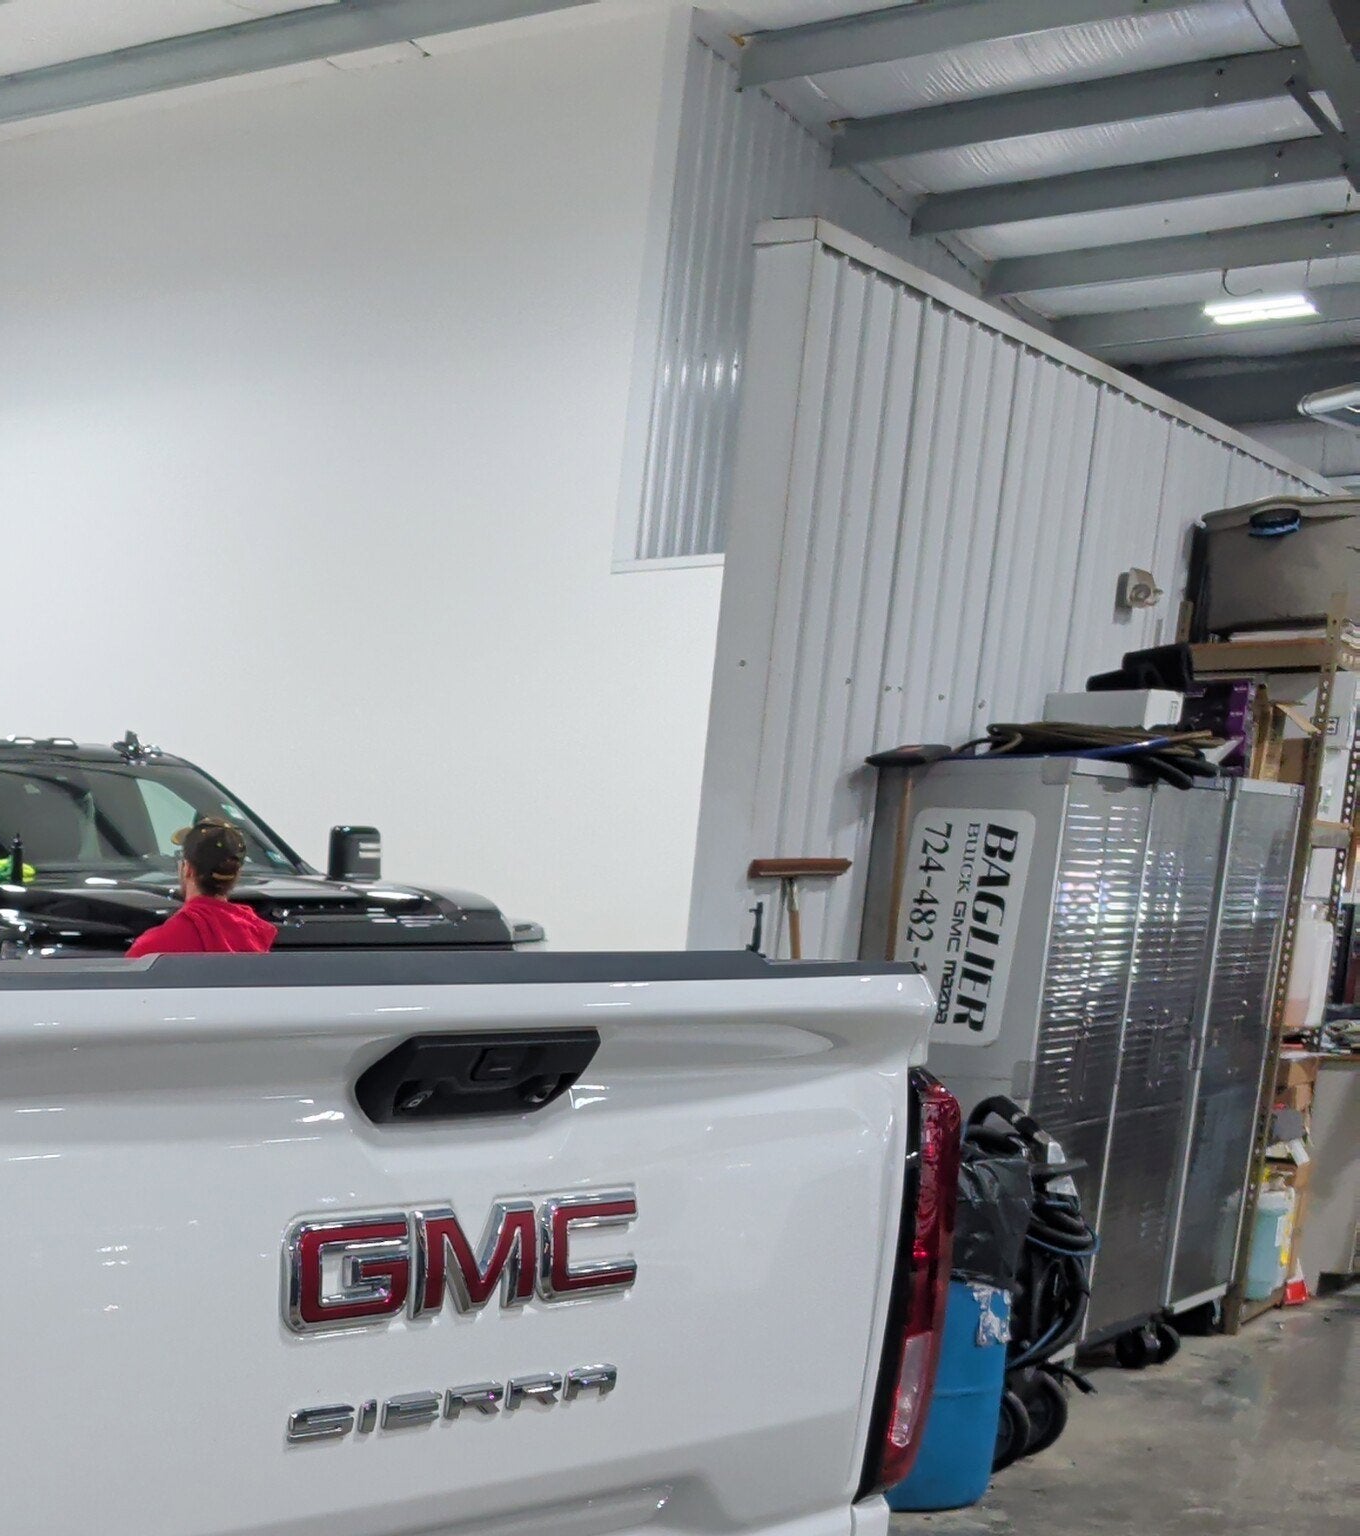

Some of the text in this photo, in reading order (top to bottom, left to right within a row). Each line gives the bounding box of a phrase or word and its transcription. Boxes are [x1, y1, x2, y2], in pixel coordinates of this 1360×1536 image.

[934, 822, 981, 1025] BUICK GMC mazda
[953, 822, 1019, 1032] BAGLIER
[281, 1186, 639, 1336] GMC
[286, 1362, 619, 1444] SIERRA
